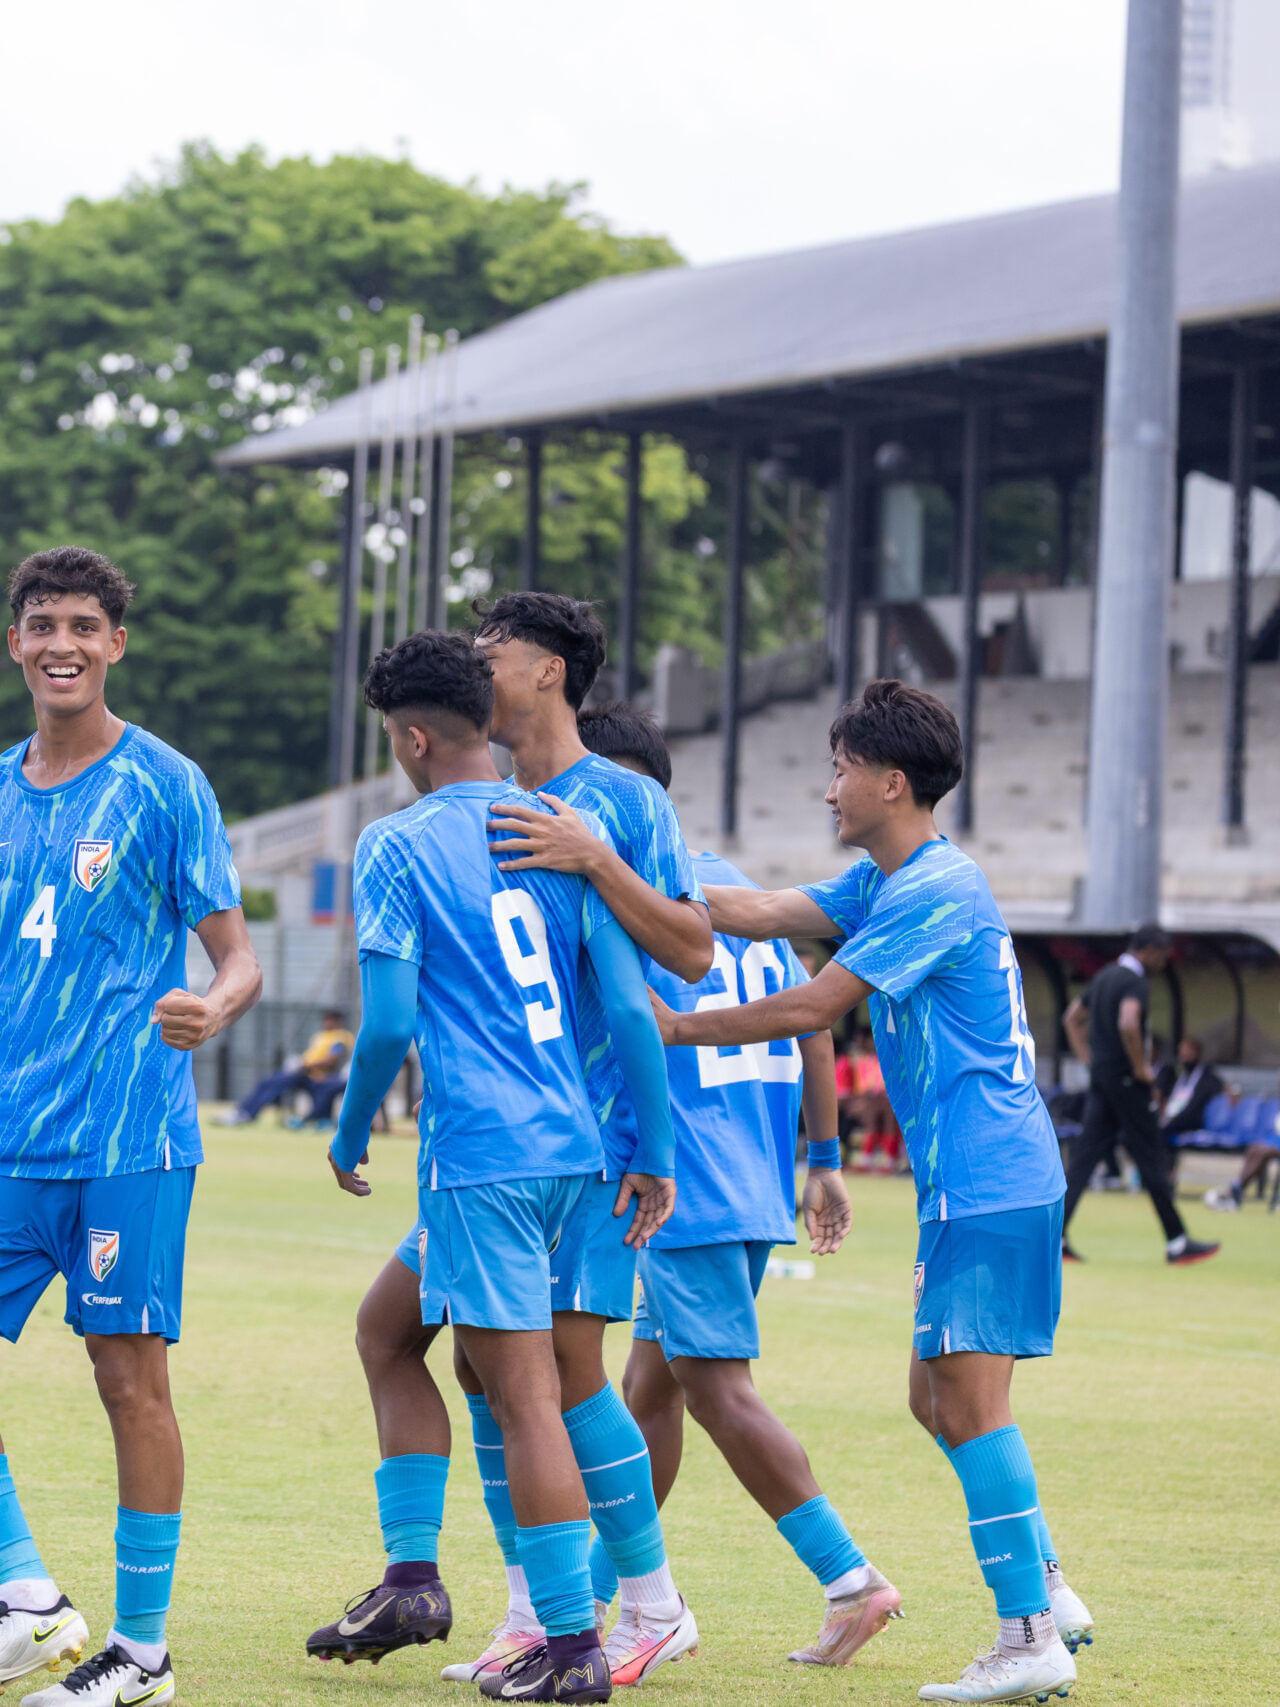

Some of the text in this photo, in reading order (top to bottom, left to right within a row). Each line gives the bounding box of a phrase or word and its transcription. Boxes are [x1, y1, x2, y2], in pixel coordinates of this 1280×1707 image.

[21, 885, 57, 958] 4
[491, 887, 564, 1045] 9
[92, 1236, 108, 1244] INDIA
